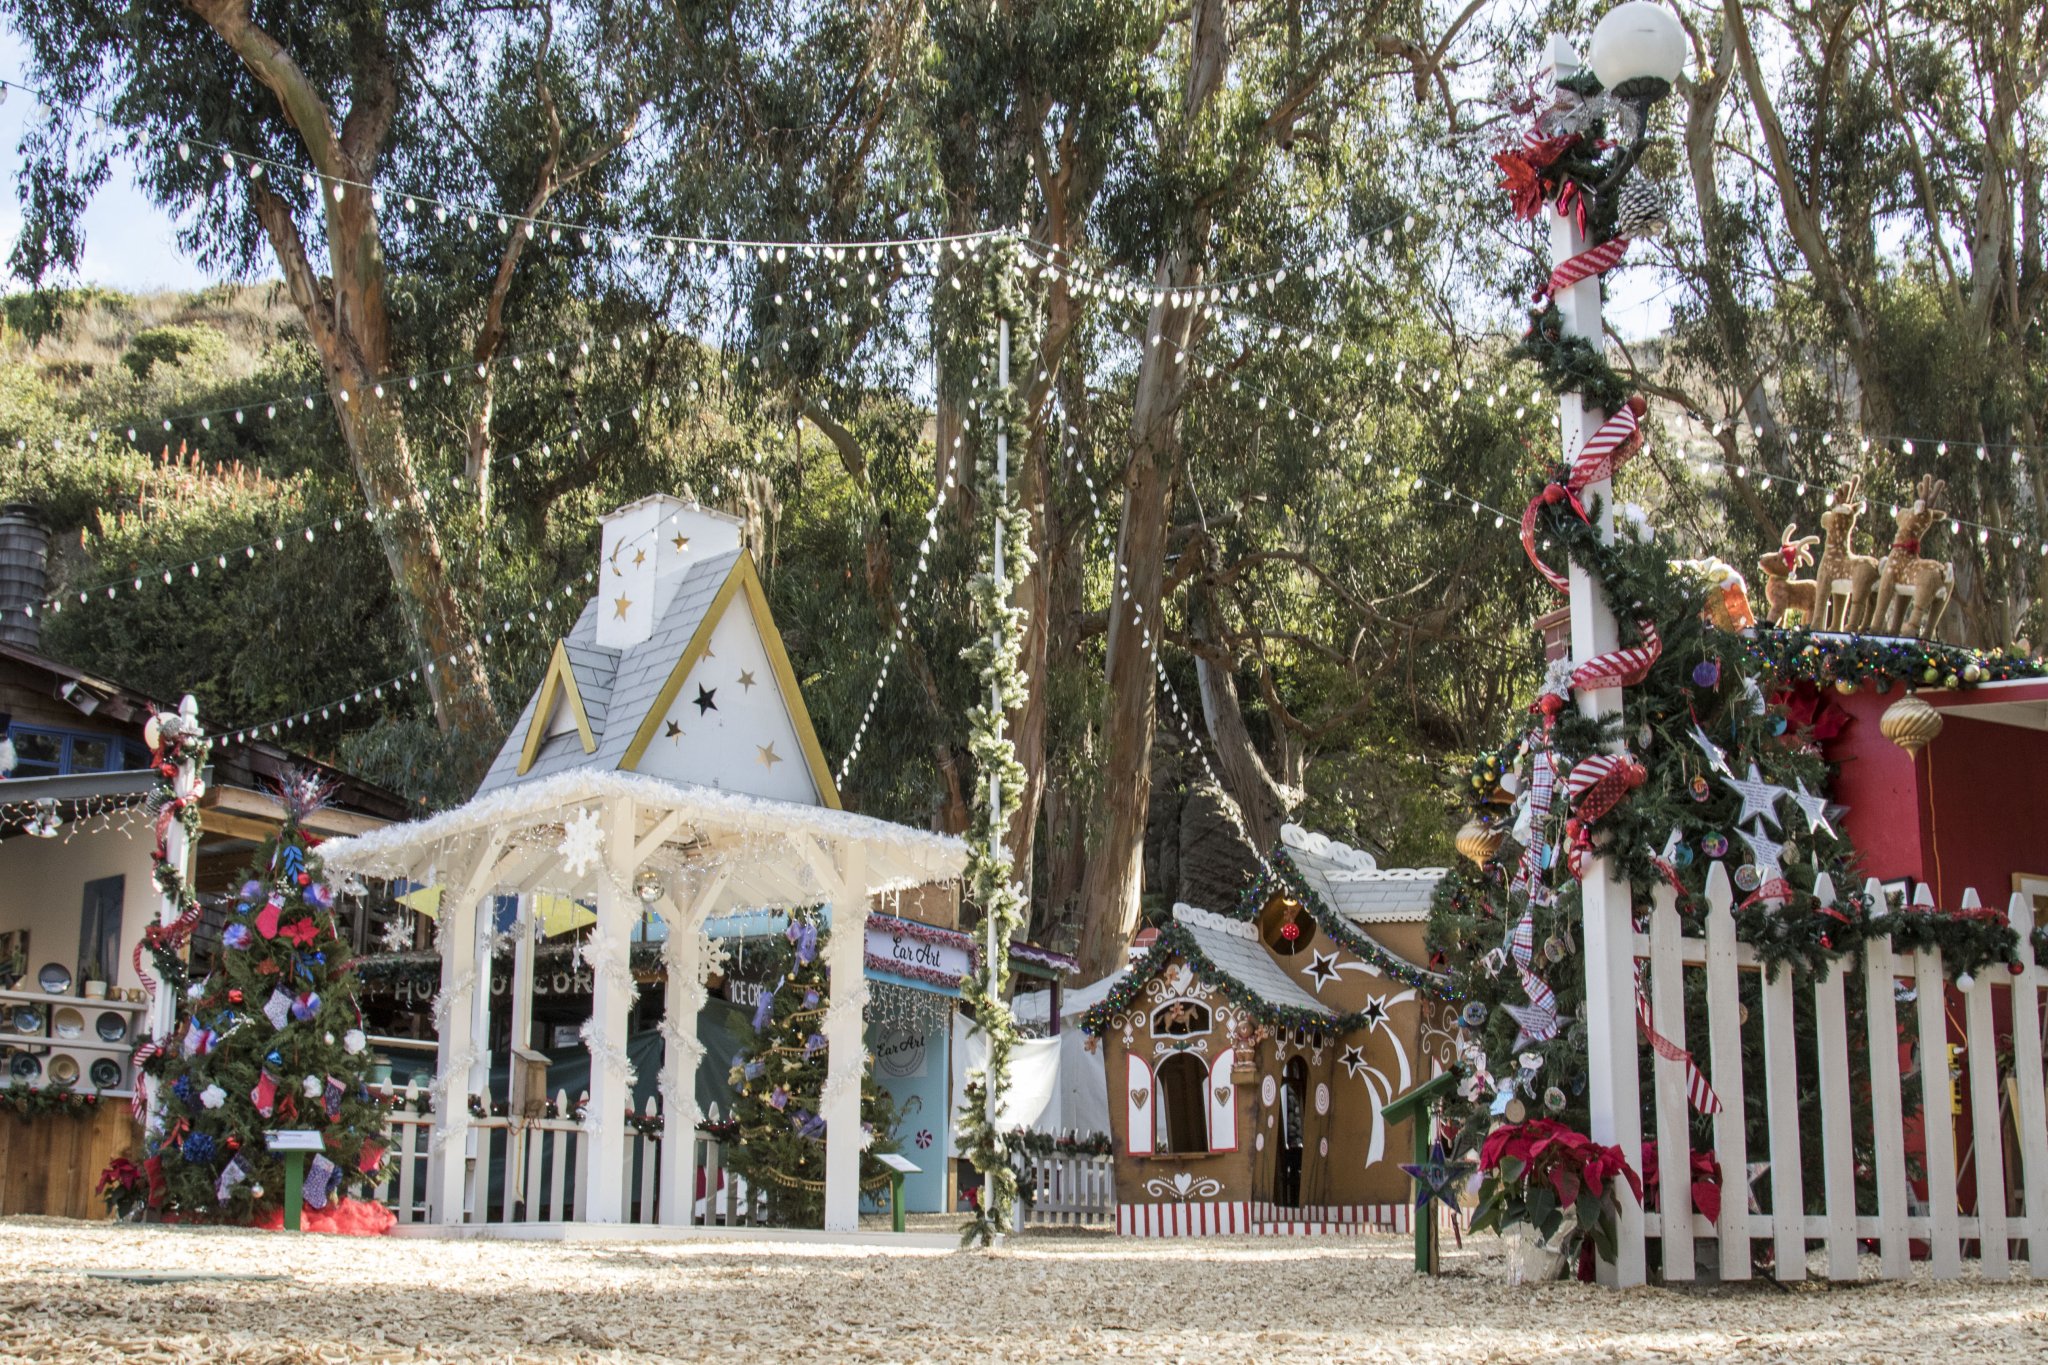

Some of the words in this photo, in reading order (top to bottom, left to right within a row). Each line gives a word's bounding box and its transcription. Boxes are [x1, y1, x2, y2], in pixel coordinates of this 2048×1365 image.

[893, 936, 914, 961] Ear
[916, 943, 940, 967] Art
[730, 980, 747, 1005] ICE
[748, 982, 765, 1007] CRE
[877, 1042, 899, 1057] Ear
[900, 1035, 925, 1051] Art
